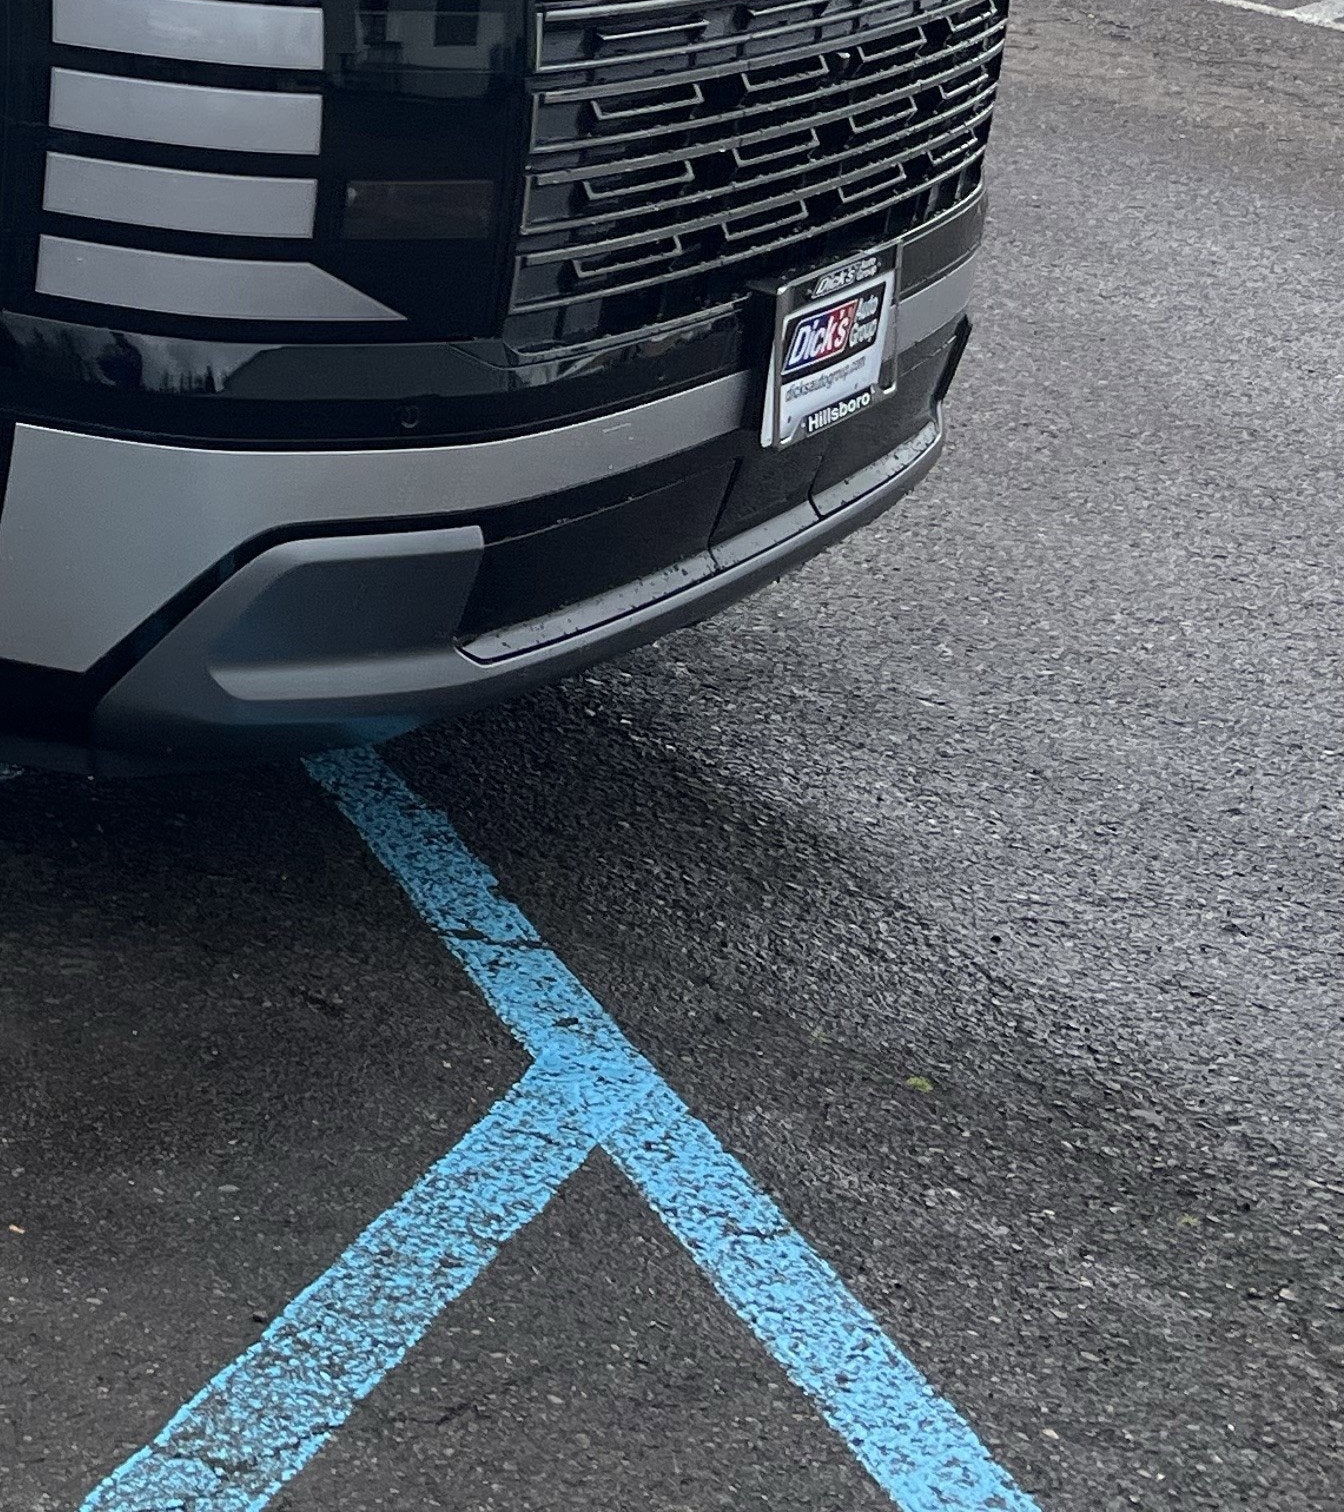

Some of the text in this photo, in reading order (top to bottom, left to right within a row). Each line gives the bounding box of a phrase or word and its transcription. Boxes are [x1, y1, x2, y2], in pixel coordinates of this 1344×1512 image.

[789, 309, 851, 366] Dick's
[849, 318, 878, 347] Group
[808, 391, 871, 432] Hillsboro
